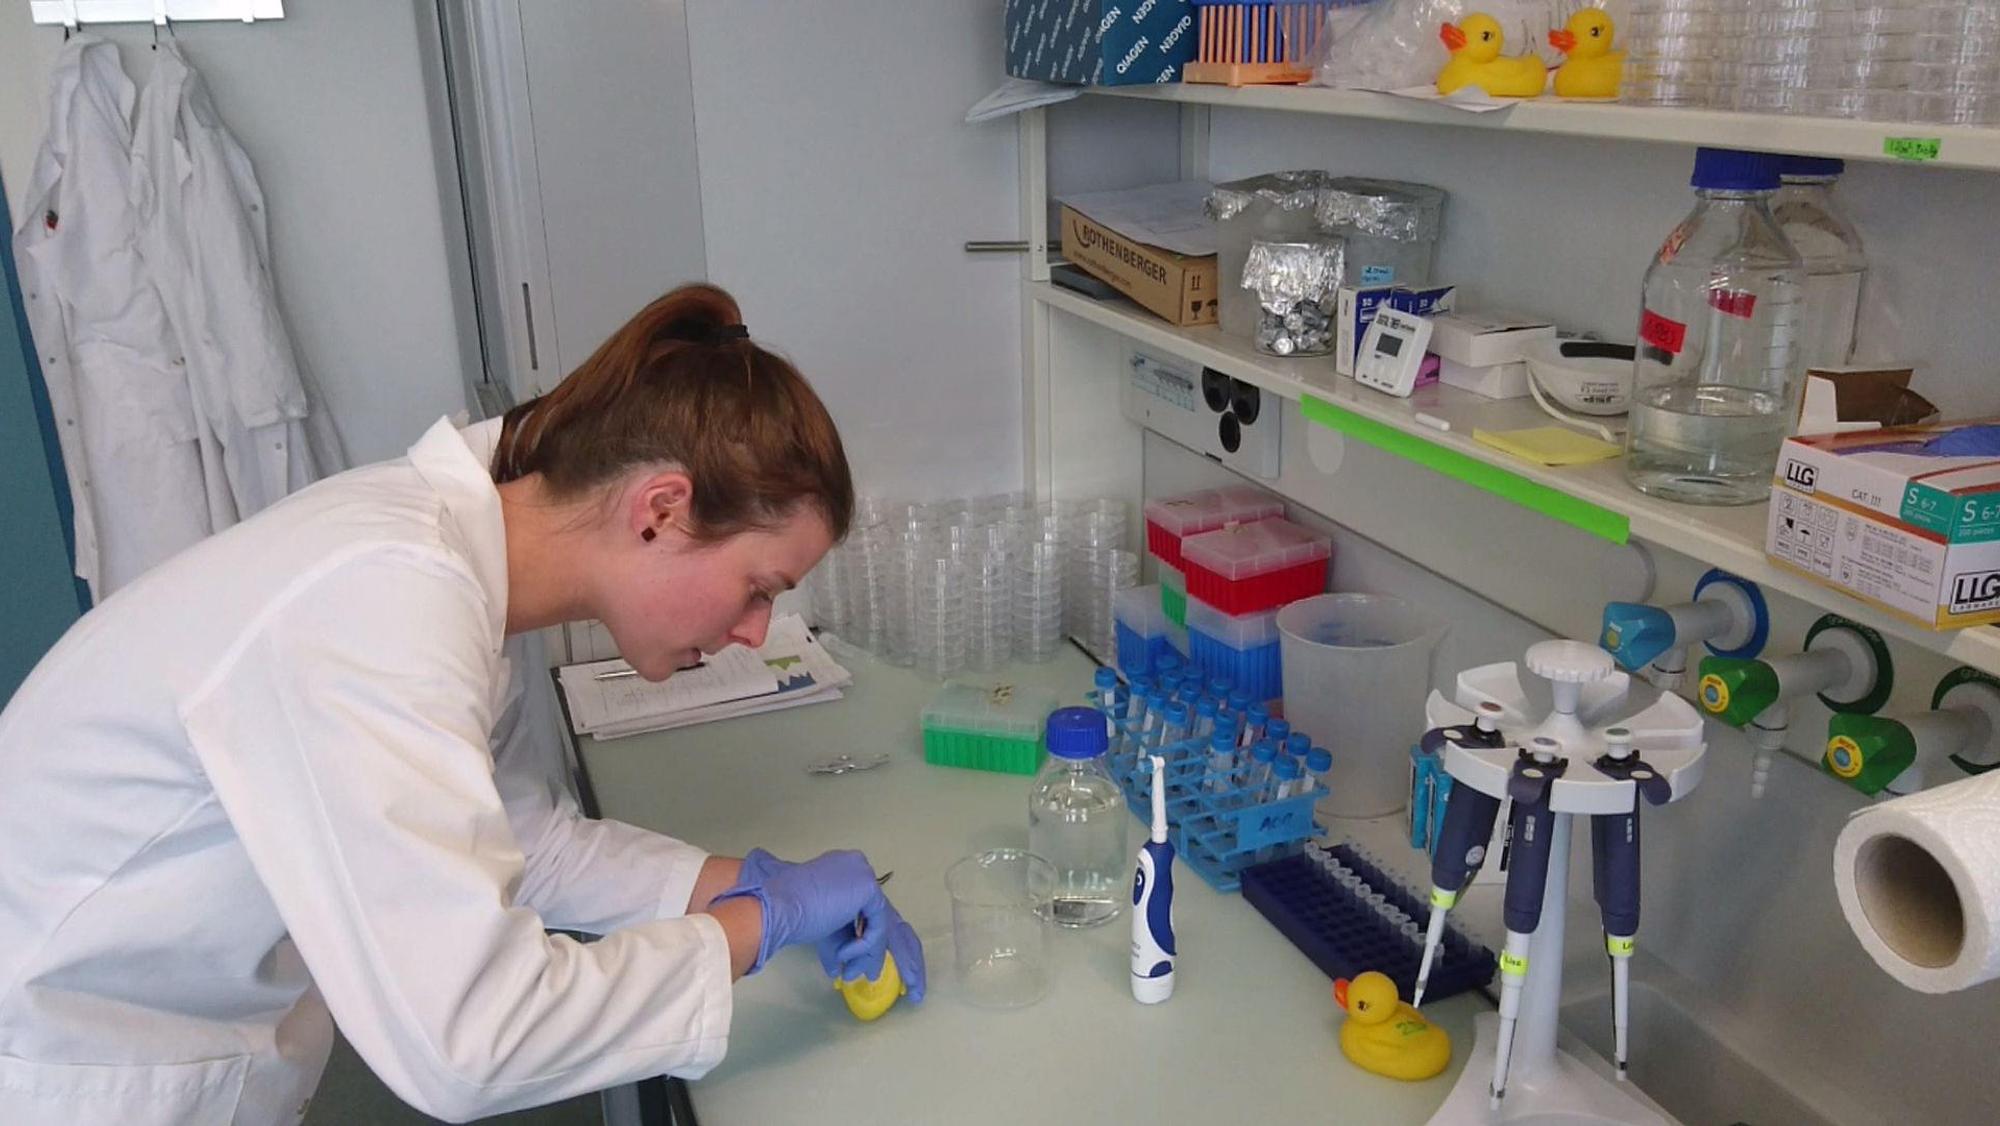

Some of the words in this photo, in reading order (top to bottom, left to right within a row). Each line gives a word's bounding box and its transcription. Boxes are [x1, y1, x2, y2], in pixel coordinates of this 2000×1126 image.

[1132, 0, 1156, 24] GEN
[1160, 15, 1192, 54] QIAGEN
[1116, 36, 1149, 74] QIAGEN
[1156, 65, 1175, 83] GEN
[1073, 219, 1167, 285] ROTHENBERGER
[1787, 463, 1814, 487] LLG
[1907, 487, 1919, 504] S
[1962, 500, 1978, 522] S
[1955, 573, 2000, 605] LLG
